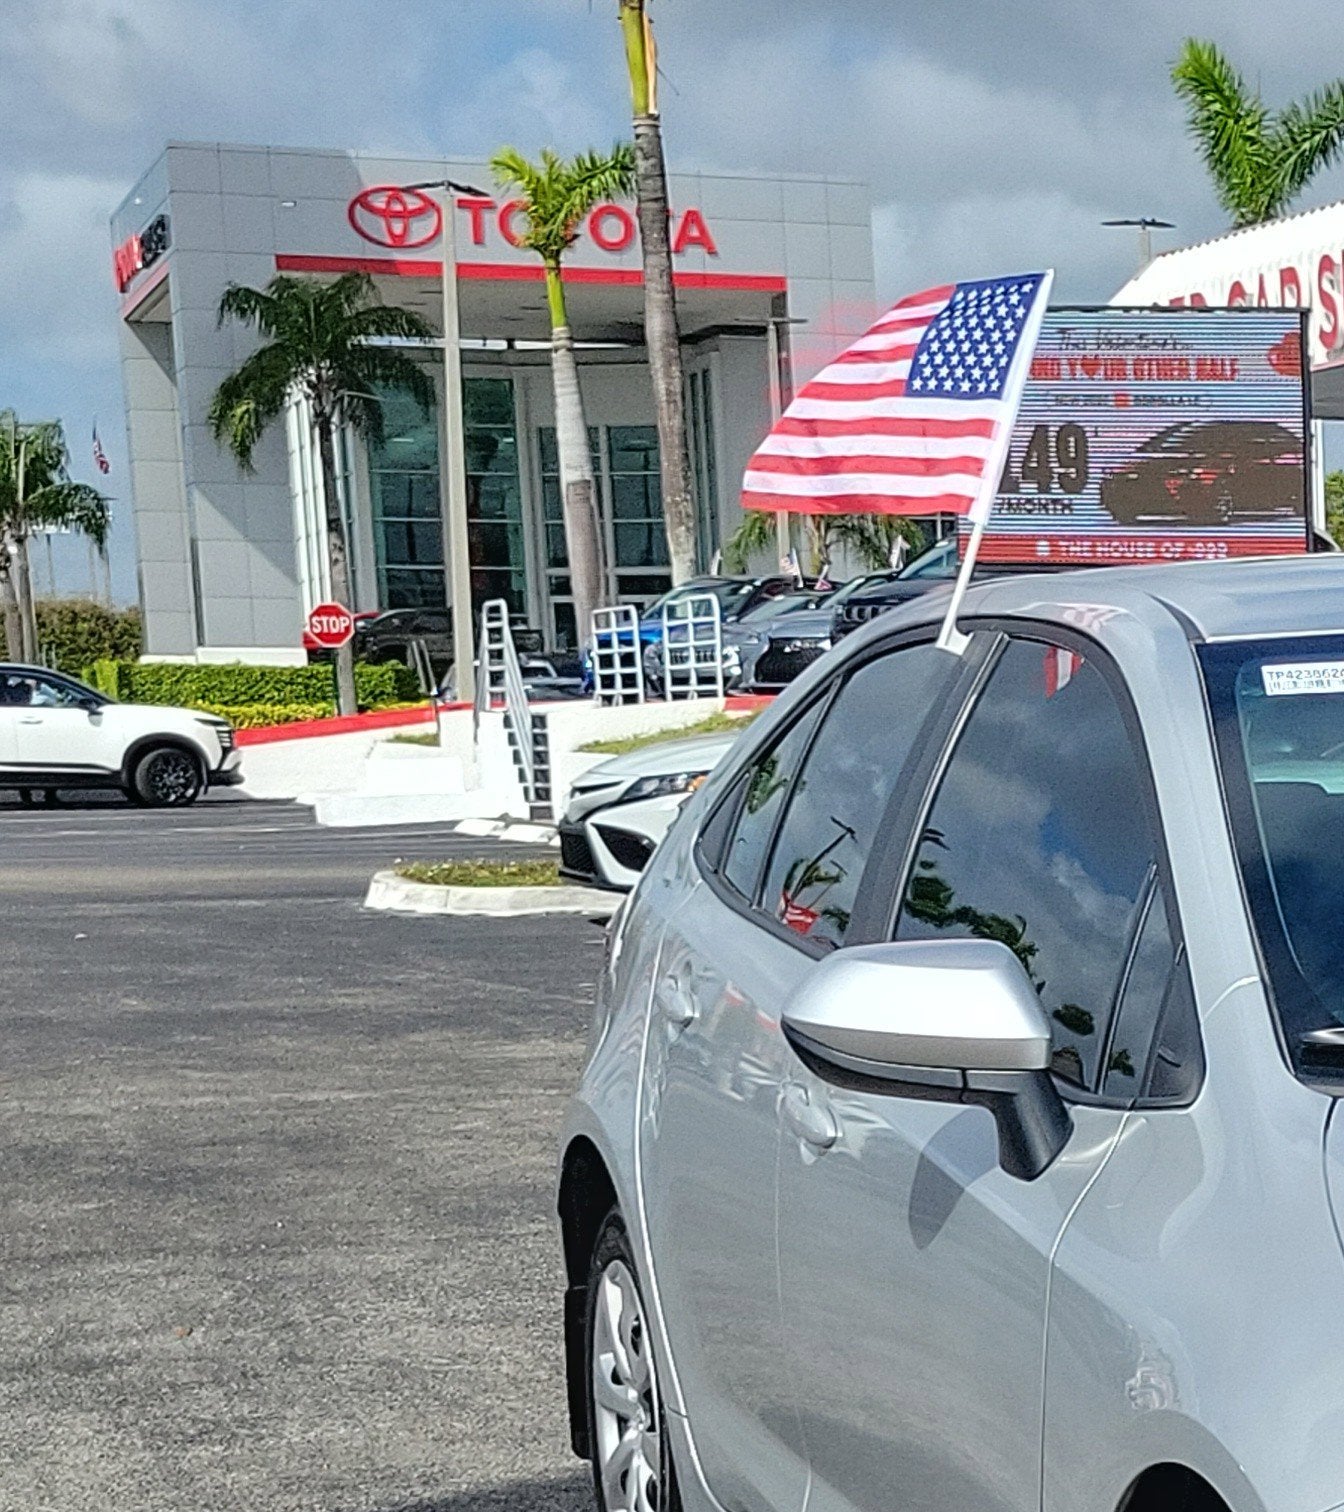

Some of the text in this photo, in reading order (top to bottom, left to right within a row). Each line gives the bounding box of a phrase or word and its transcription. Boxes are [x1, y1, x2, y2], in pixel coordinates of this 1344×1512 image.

[457, 198, 718, 256] TOOA
[1058, 541, 1093, 557] THE
[1096, 541, 1156, 557] HOUSE
[311, 615, 350, 634] STOP
